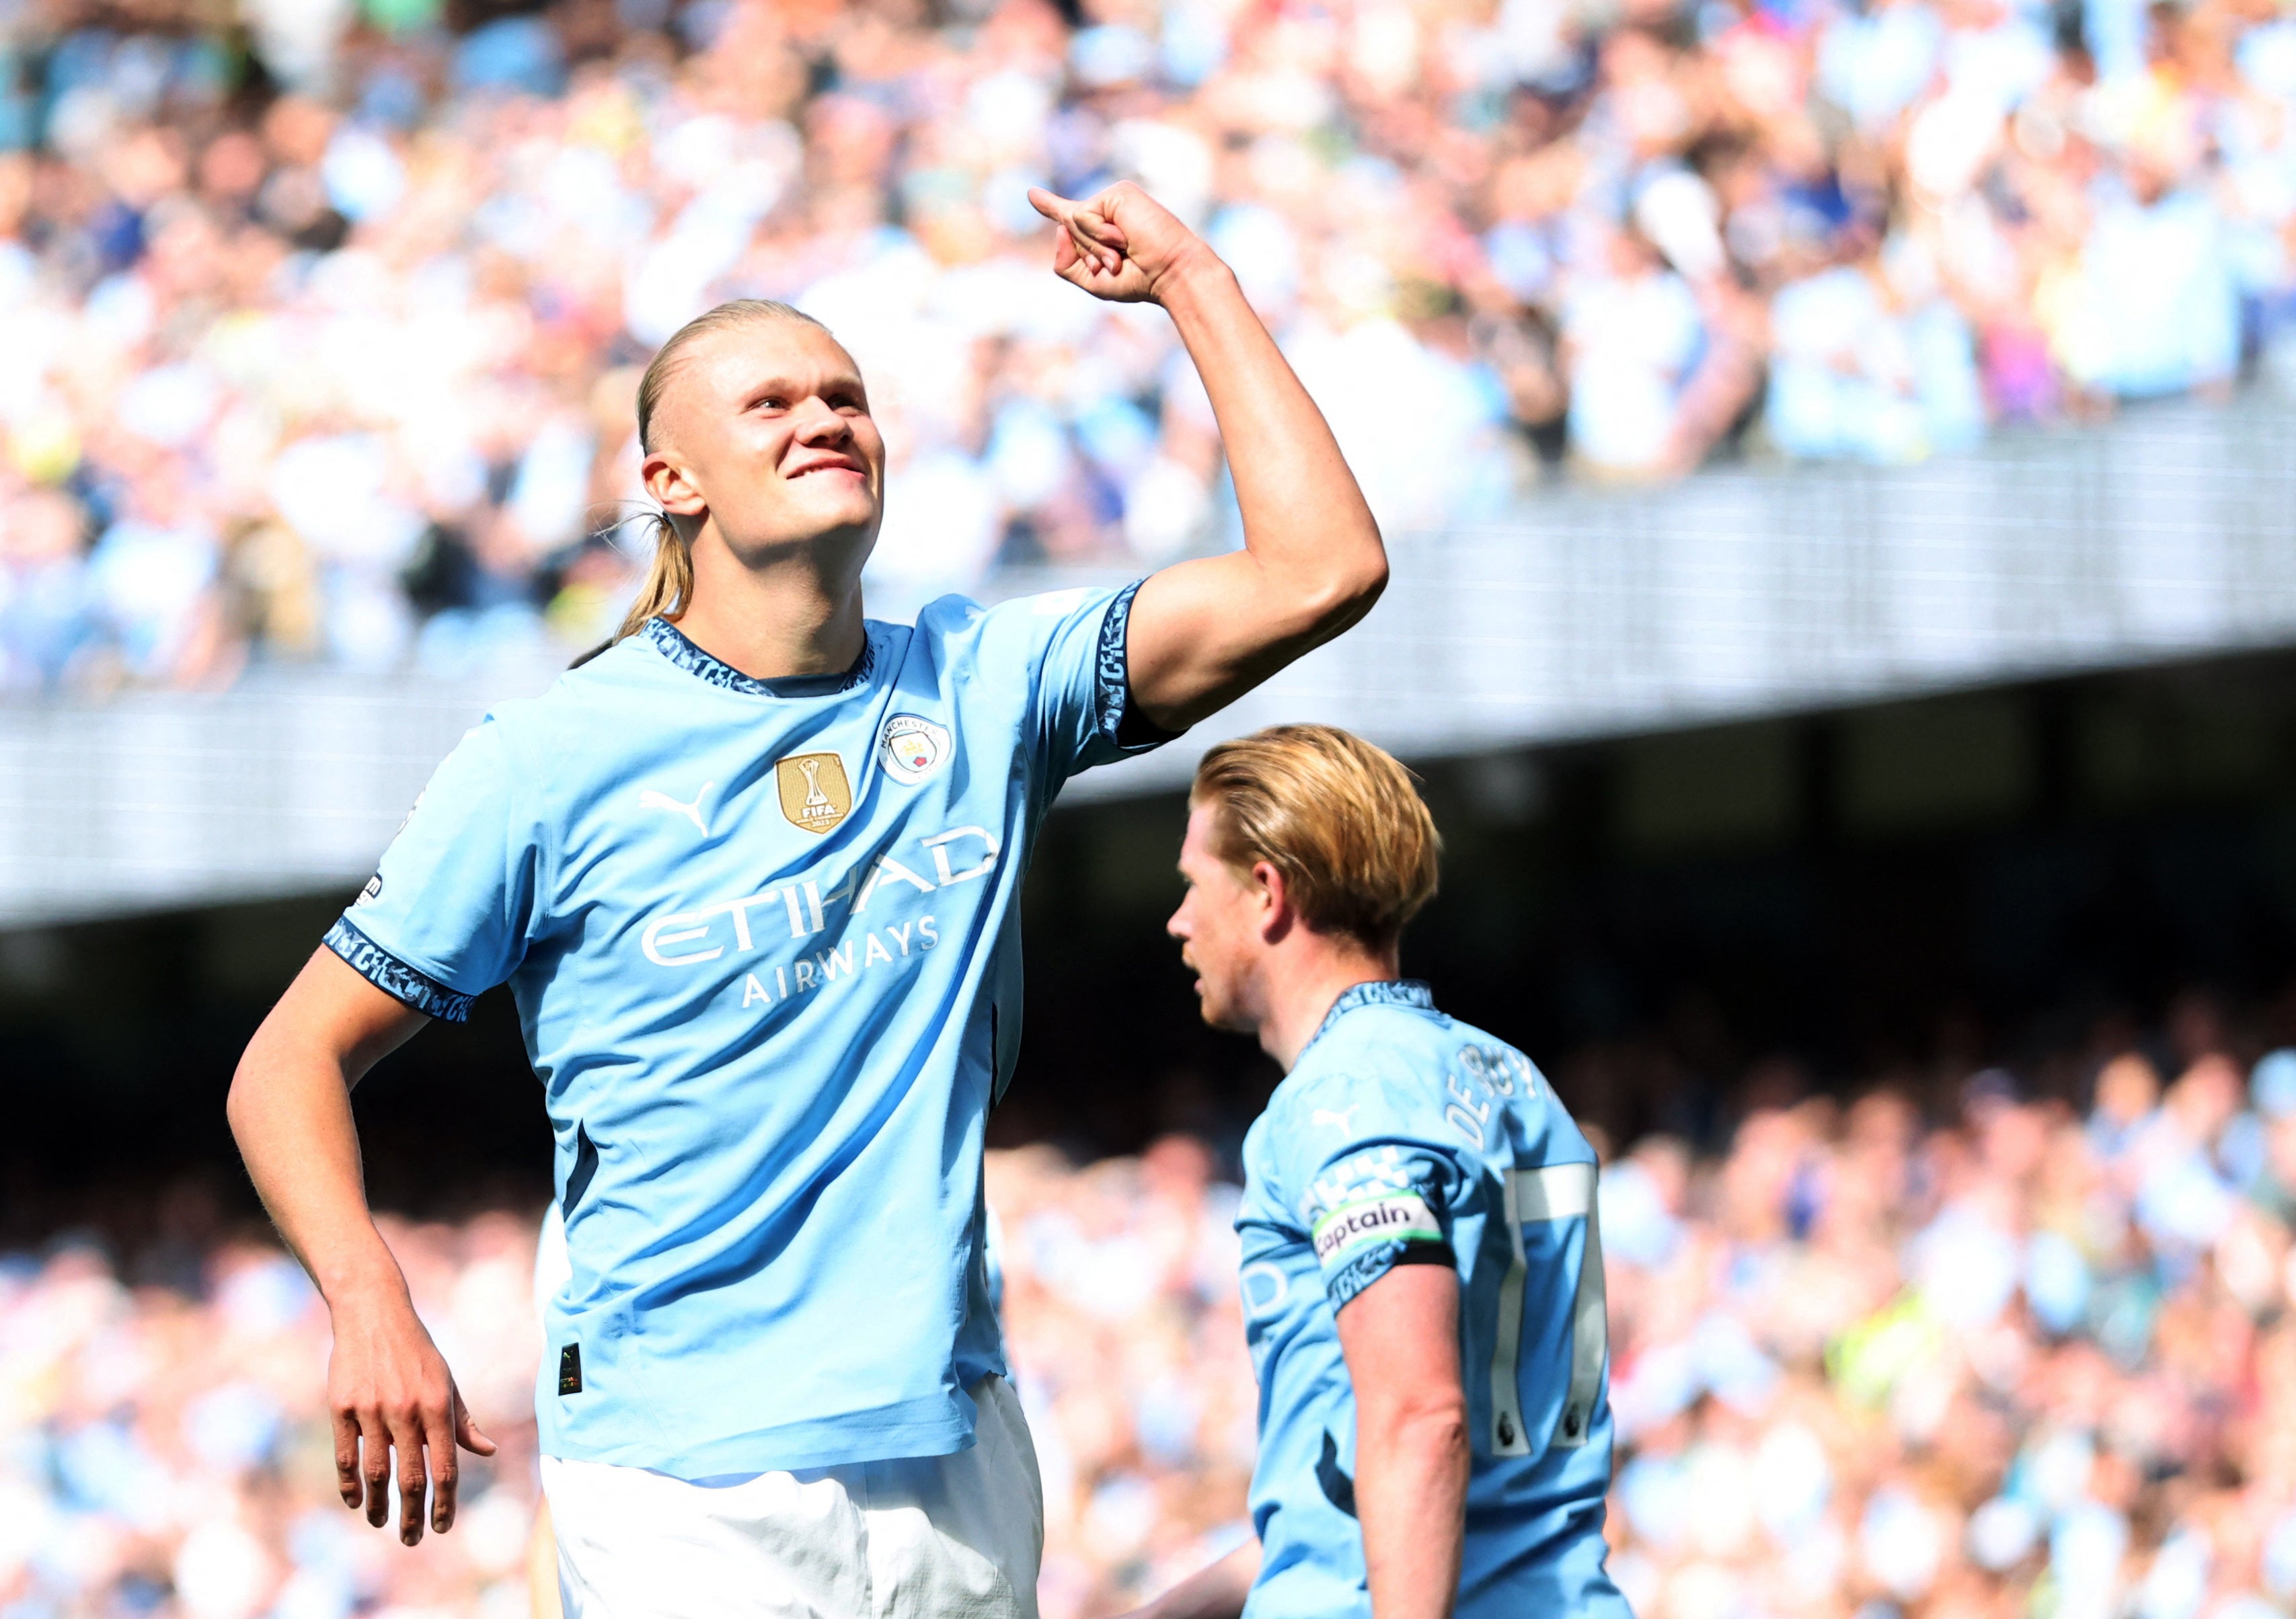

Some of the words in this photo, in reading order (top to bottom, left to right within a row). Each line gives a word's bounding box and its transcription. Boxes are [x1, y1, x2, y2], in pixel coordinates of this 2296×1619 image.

[802, 804, 835, 818] FIFA
[640, 825, 1000, 967] ETIHAD
[741, 914, 940, 1009] AIRWAYS
[1445, 1072, 1491, 1152] DE
[1490, 1162, 1607, 1456] 17
